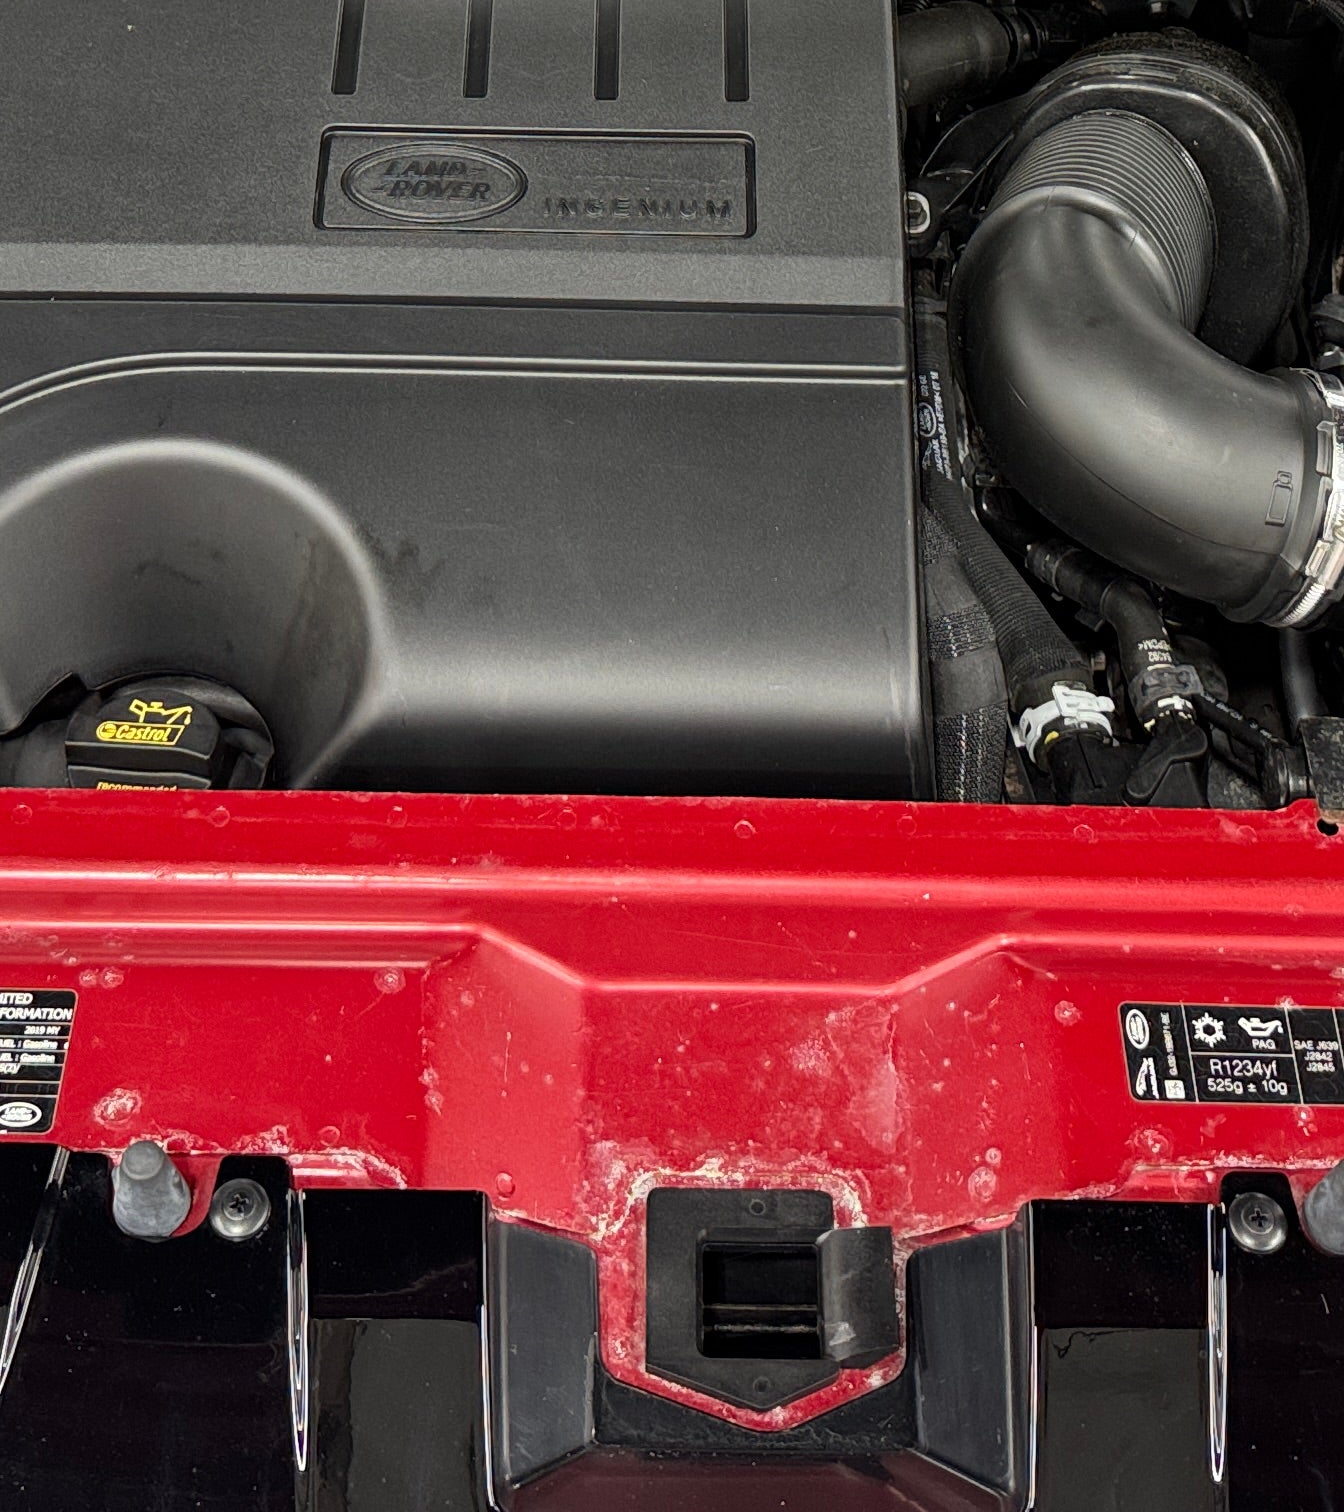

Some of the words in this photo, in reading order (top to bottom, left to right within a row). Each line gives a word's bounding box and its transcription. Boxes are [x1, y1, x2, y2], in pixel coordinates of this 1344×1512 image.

[383, 161, 469, 177] LAND
[388, 180, 491, 201] ROVER
[543, 196, 734, 221] INGENIUM
[115, 724, 171, 742] Castrol
[24, 1026, 46, 1035] 2019
[46, 1026, 61, 1035] MY
[1252, 1039, 1276, 1049] PAG
[1293, 1040, 1314, 1050] SAE
[1316, 1041, 1339, 1051] J639
[1209, 1059, 1278, 1079] R1234yf
[1207, 1080, 1242, 1094] 525g
[1262, 1080, 1288, 1095] 10g
